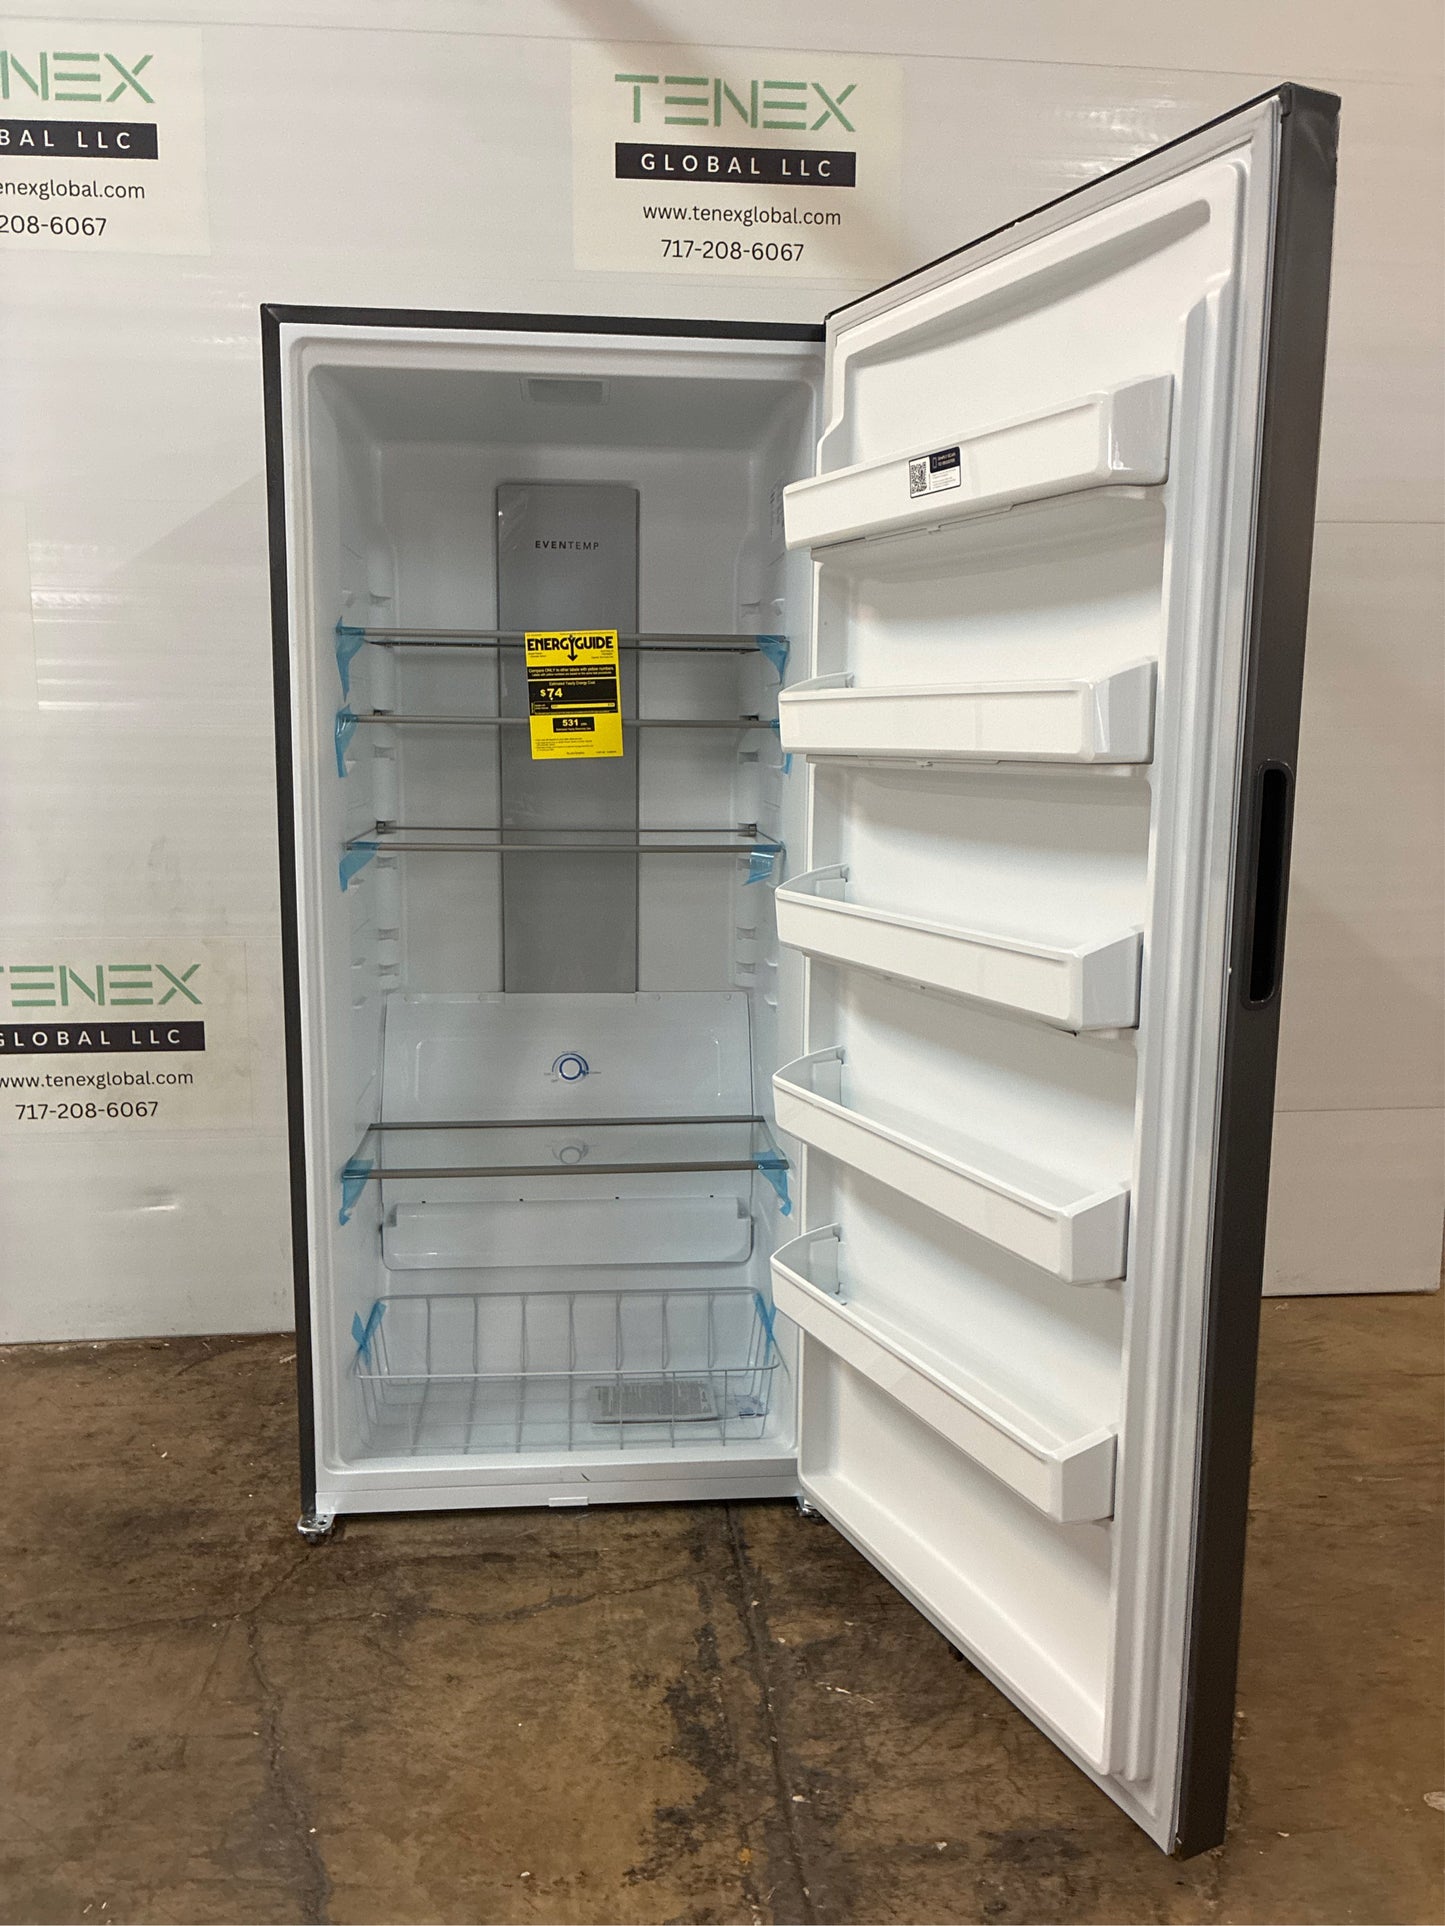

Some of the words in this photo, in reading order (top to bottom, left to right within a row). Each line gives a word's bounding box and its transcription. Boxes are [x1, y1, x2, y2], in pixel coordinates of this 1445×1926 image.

[615, 73, 857, 132] TENEX
[78, 131, 130, 149] LLC
[641, 153, 760, 174] GLOBAL
[781, 158, 831, 178] LLC
[643, 206, 841, 227] www.tenexglobal.com
[660, 239, 804, 262] 717-208-6067
[535, 540, 599, 550] EVENTEMP
[562, 719, 579, 727] 531
[0, 964, 203, 1006] ENEX
[131, 1030, 180, 1045] LLC
[16, 1102, 158, 1120] 717-208-6067
